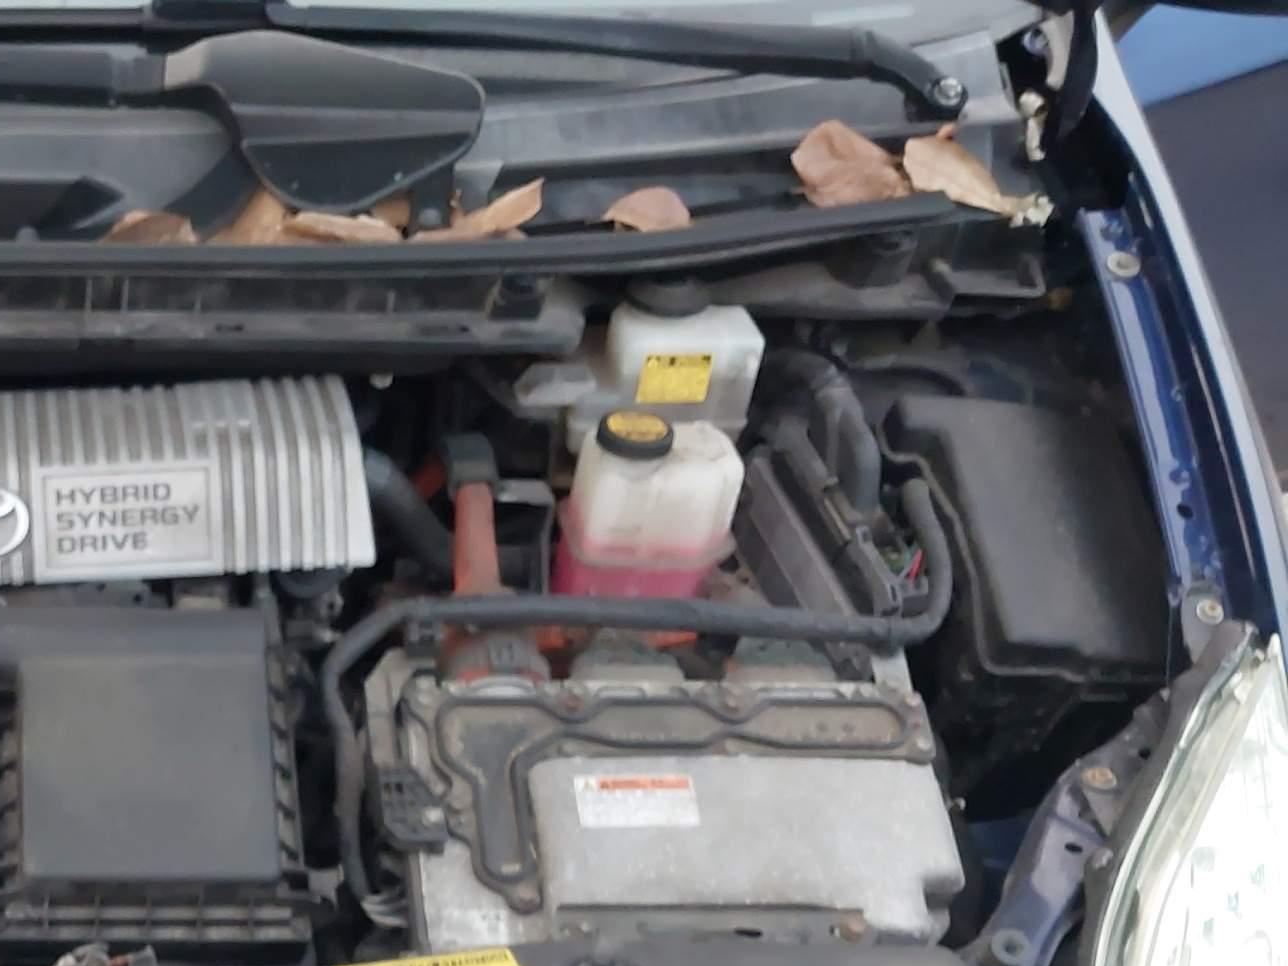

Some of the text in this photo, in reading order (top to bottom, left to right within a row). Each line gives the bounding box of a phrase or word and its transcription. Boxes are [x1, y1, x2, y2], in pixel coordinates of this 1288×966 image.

[55, 483, 171, 505] HYBRID
[56, 503, 200, 531] SYNERGY
[57, 531, 148, 554] DRIVE
